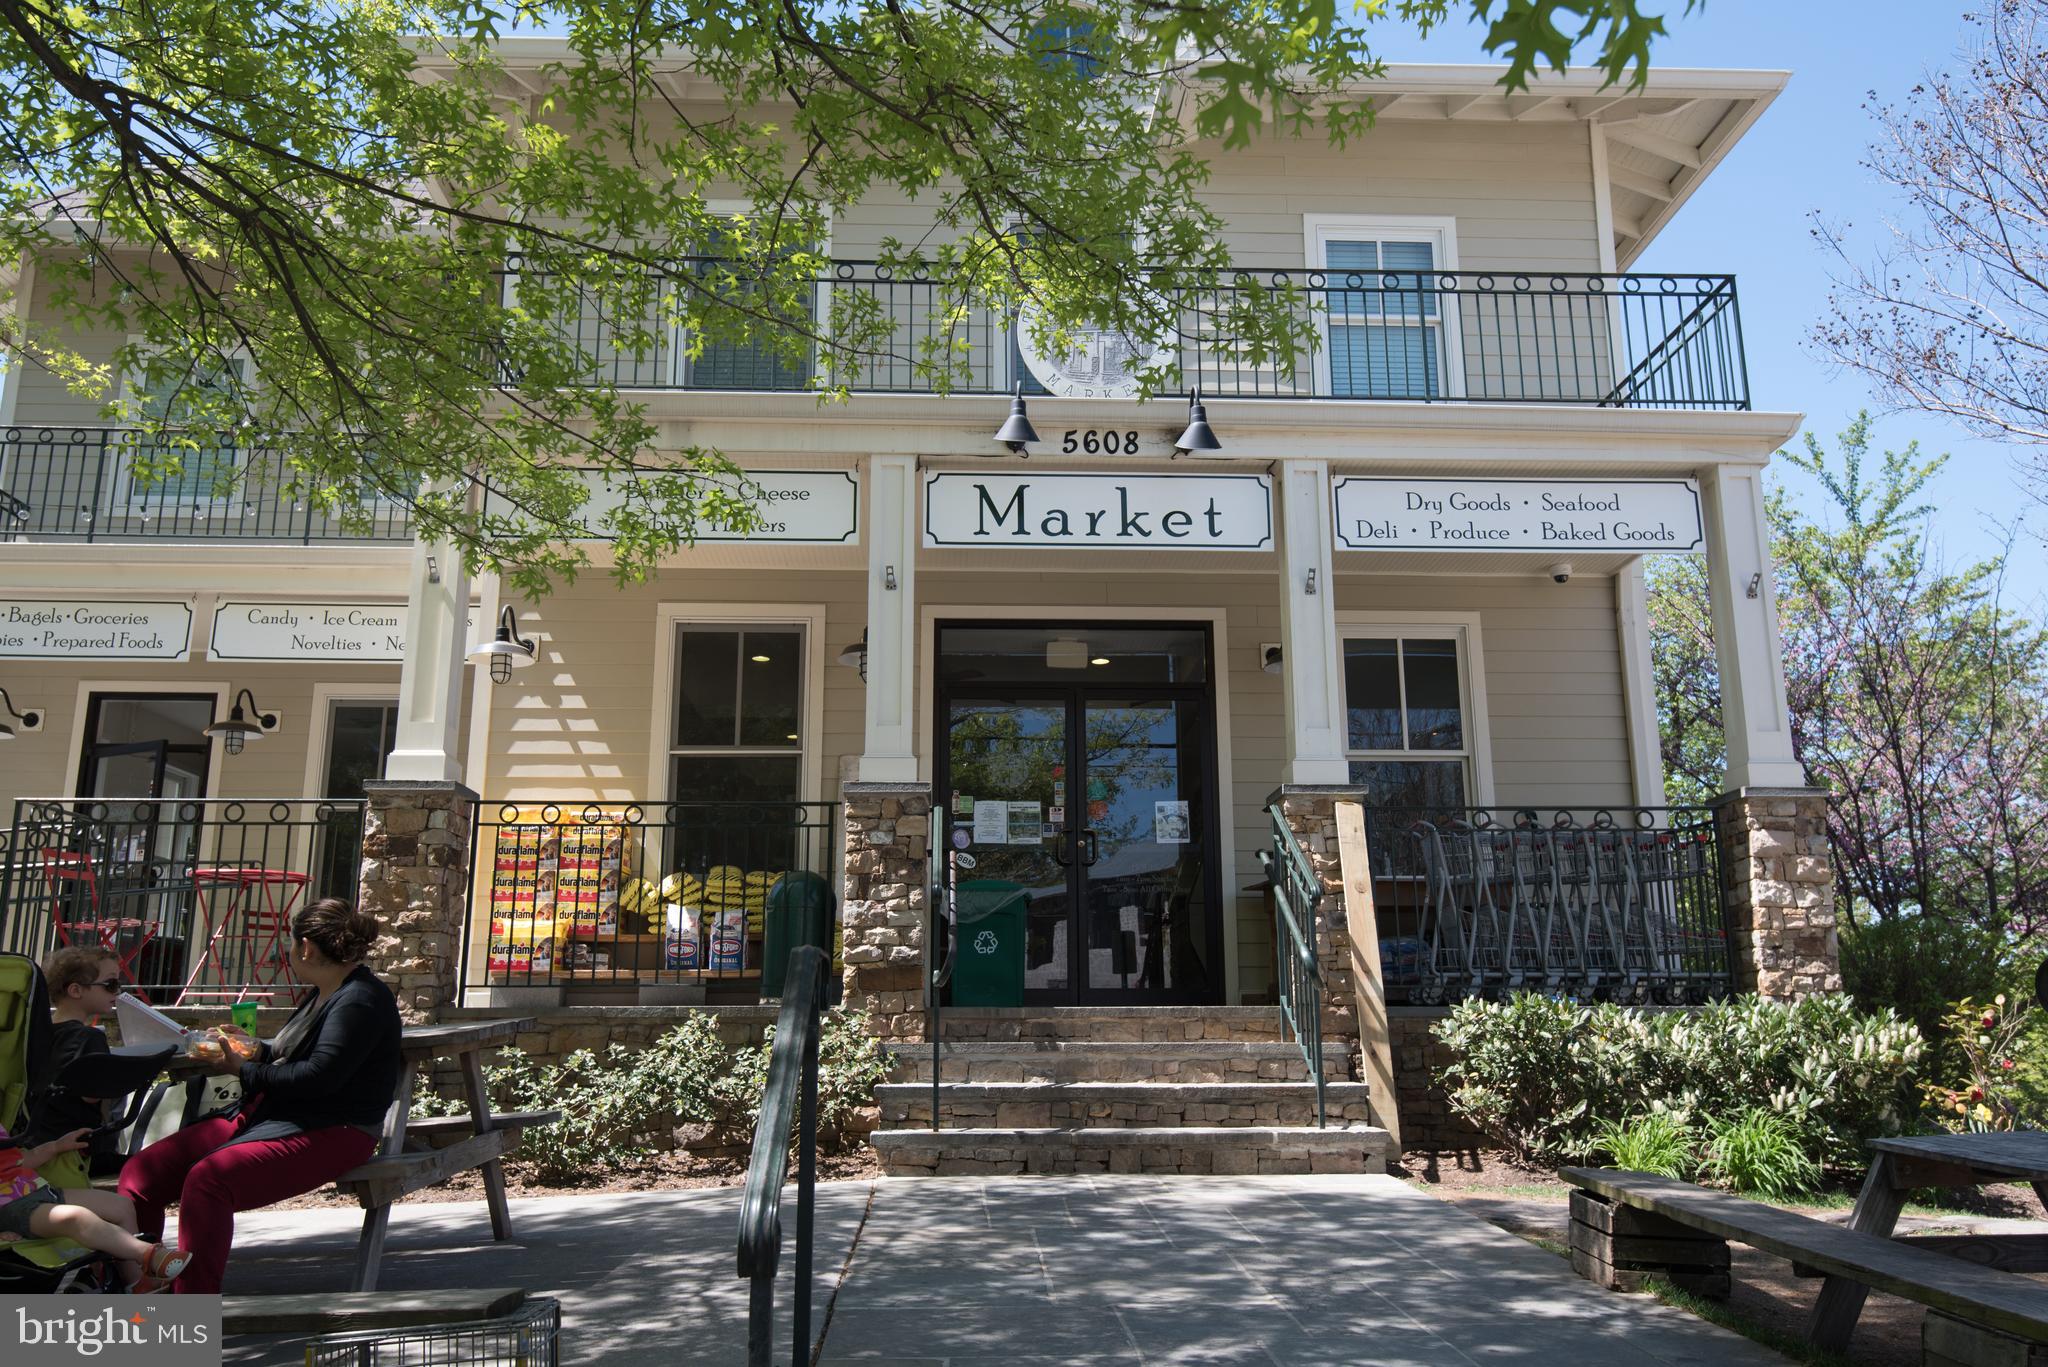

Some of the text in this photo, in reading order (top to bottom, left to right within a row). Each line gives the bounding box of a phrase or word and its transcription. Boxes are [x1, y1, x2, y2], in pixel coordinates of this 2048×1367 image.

[1062, 430, 1140, 455] 5608
[738, 481, 810, 501] Cheese
[972, 484, 1223, 538] Market
[1405, 492, 1622, 514] Dry Goods Seafood
[1356, 519, 1676, 542] Deli Produce Baked Goods
[8, 606, 149, 627] Bagels Groceries
[248, 609, 398, 627] Candy Ice Cream
[42, 630, 116, 652] Prepared
[118, 632, 164, 650] Foods
[291, 634, 362, 651] Novelties
[957, 853, 975, 868] BBM
